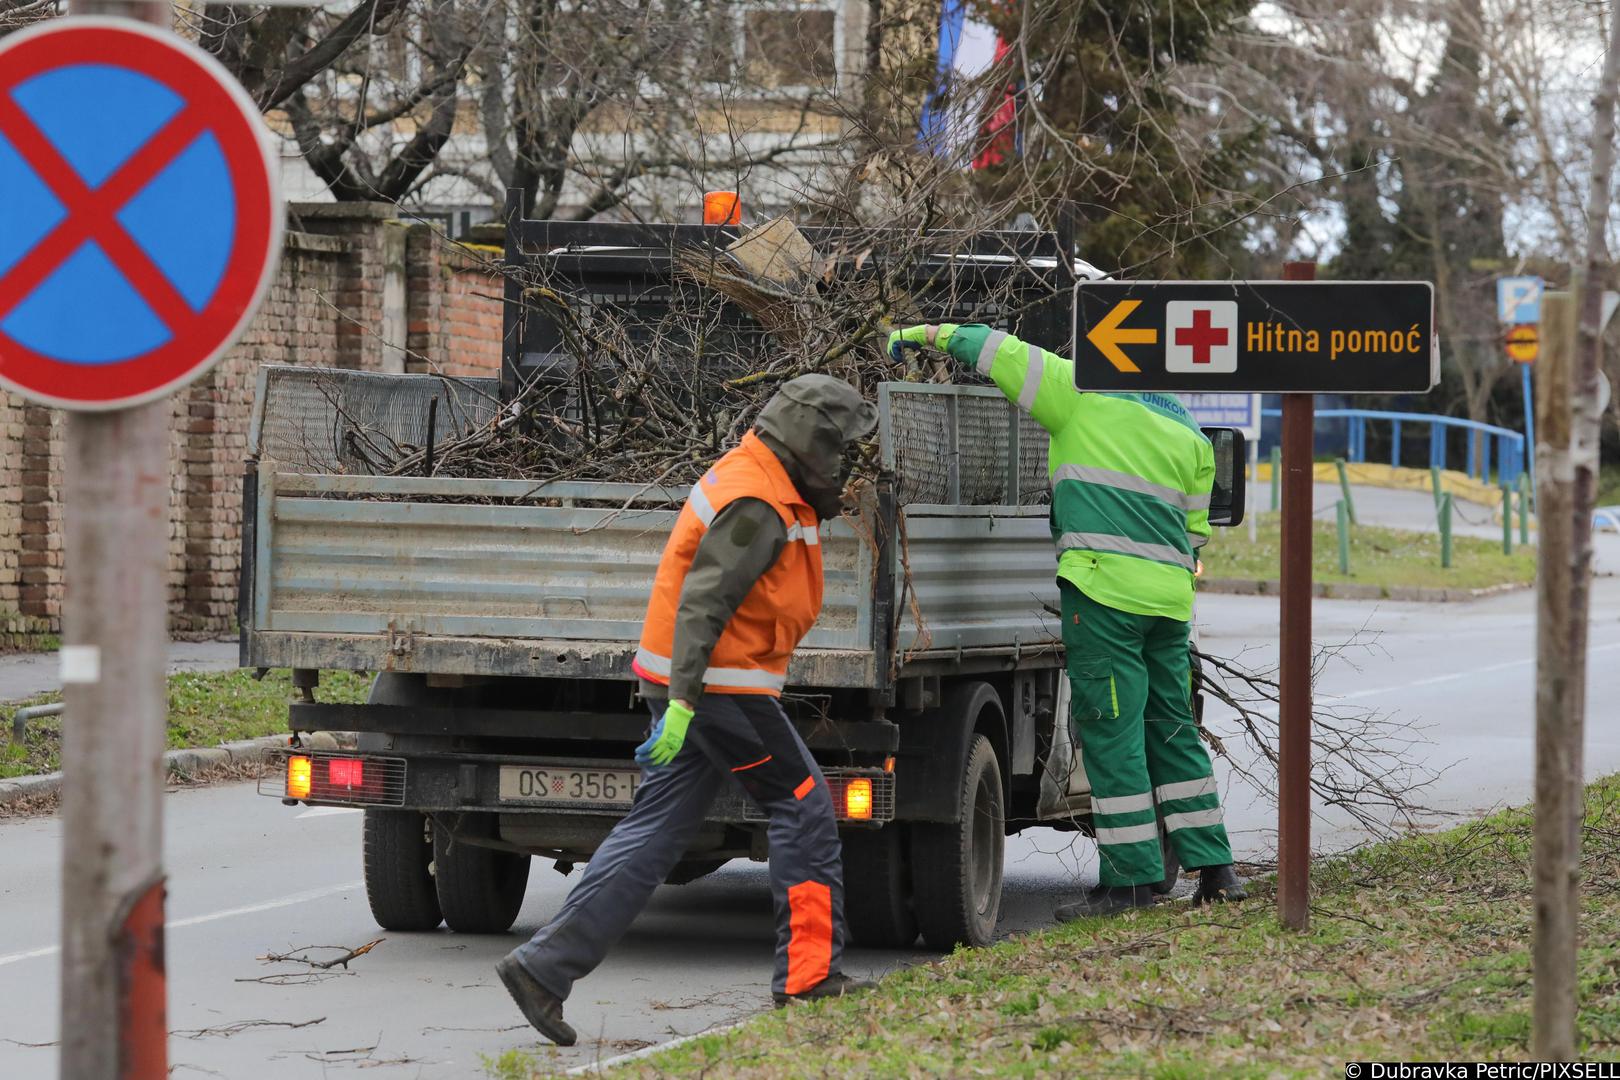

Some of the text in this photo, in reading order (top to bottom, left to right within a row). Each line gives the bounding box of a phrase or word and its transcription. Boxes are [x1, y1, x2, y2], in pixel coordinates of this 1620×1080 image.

[1246, 321, 1421, 361] Hitna pomoć
[519, 770, 548, 797] OS
